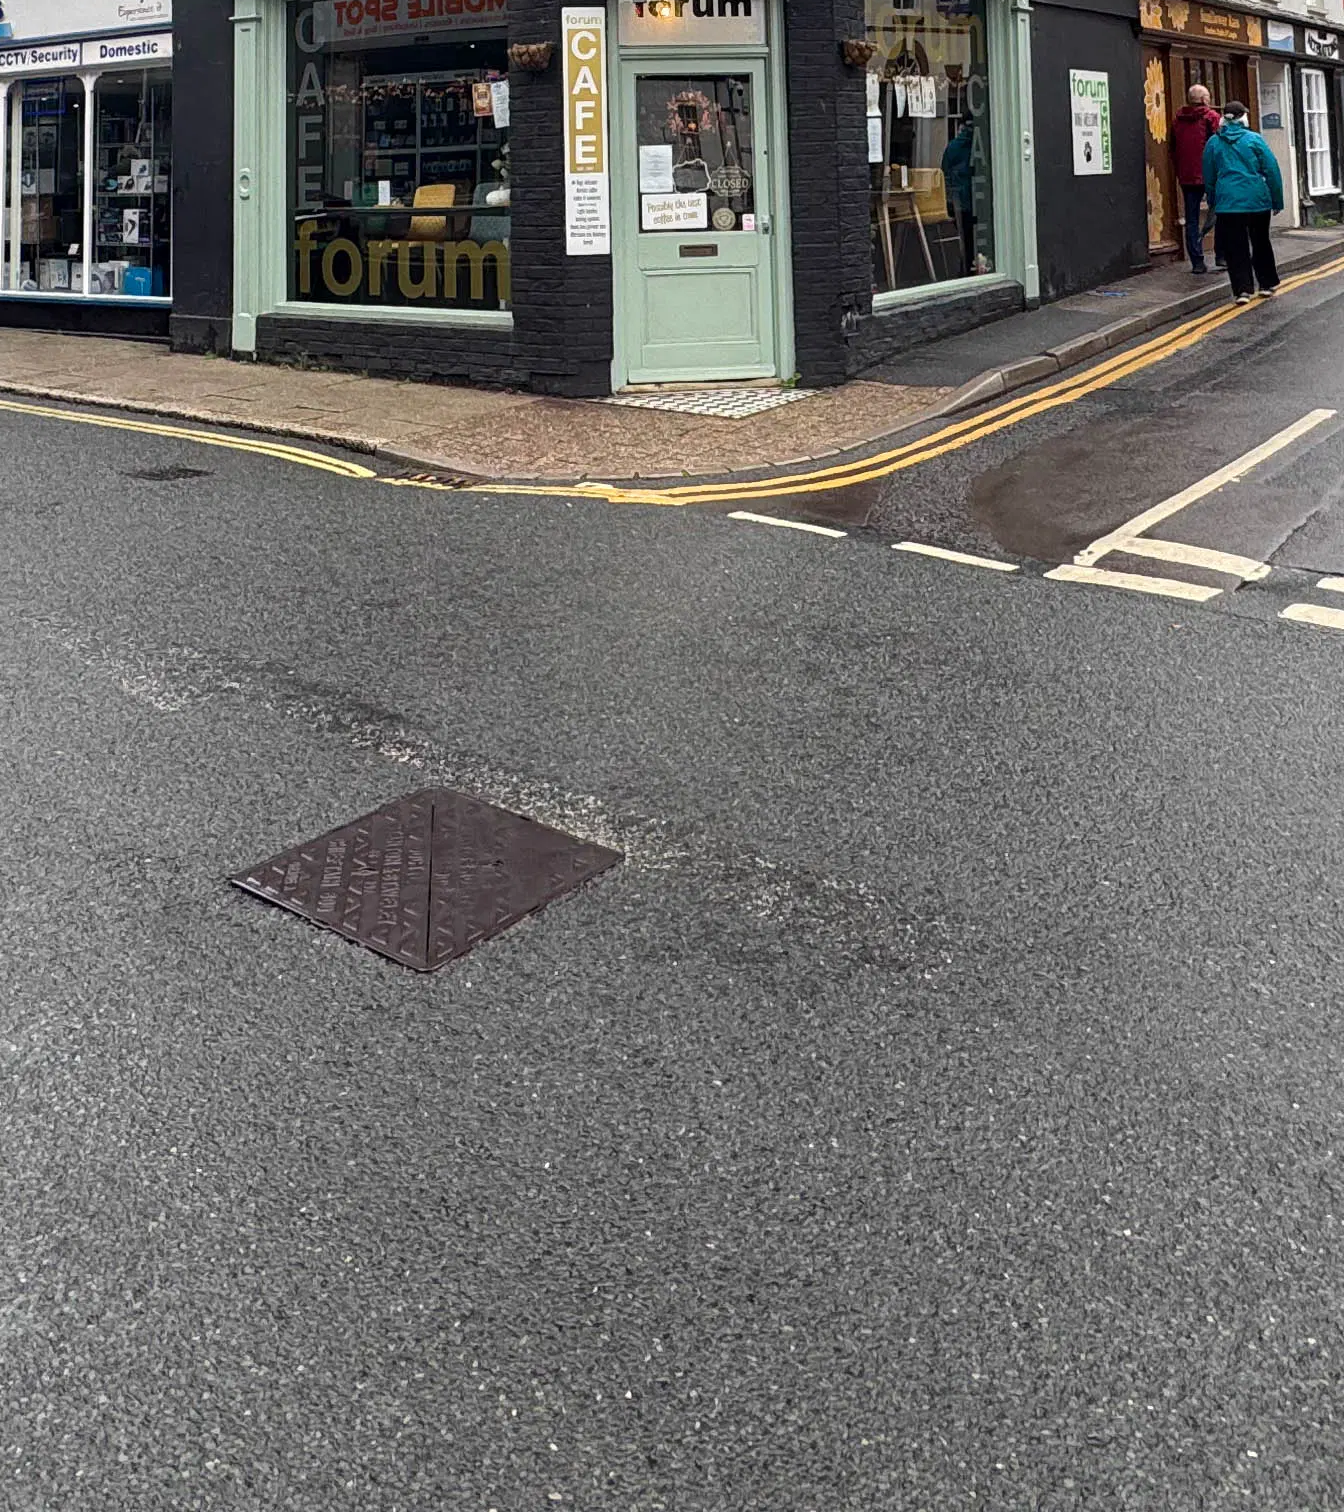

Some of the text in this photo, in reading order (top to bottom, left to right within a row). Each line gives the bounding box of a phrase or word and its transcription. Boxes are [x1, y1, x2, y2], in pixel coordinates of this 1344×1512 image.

[566, 15, 602, 25] forum
[99, 40, 159, 59] Domestic
[571, 30, 599, 164] CAFE
[1072, 72, 1108, 98] forum
[1101, 102, 1109, 168] CAFE
[711, 178, 749, 189] CLOSED
[293, 220, 511, 301] forum
